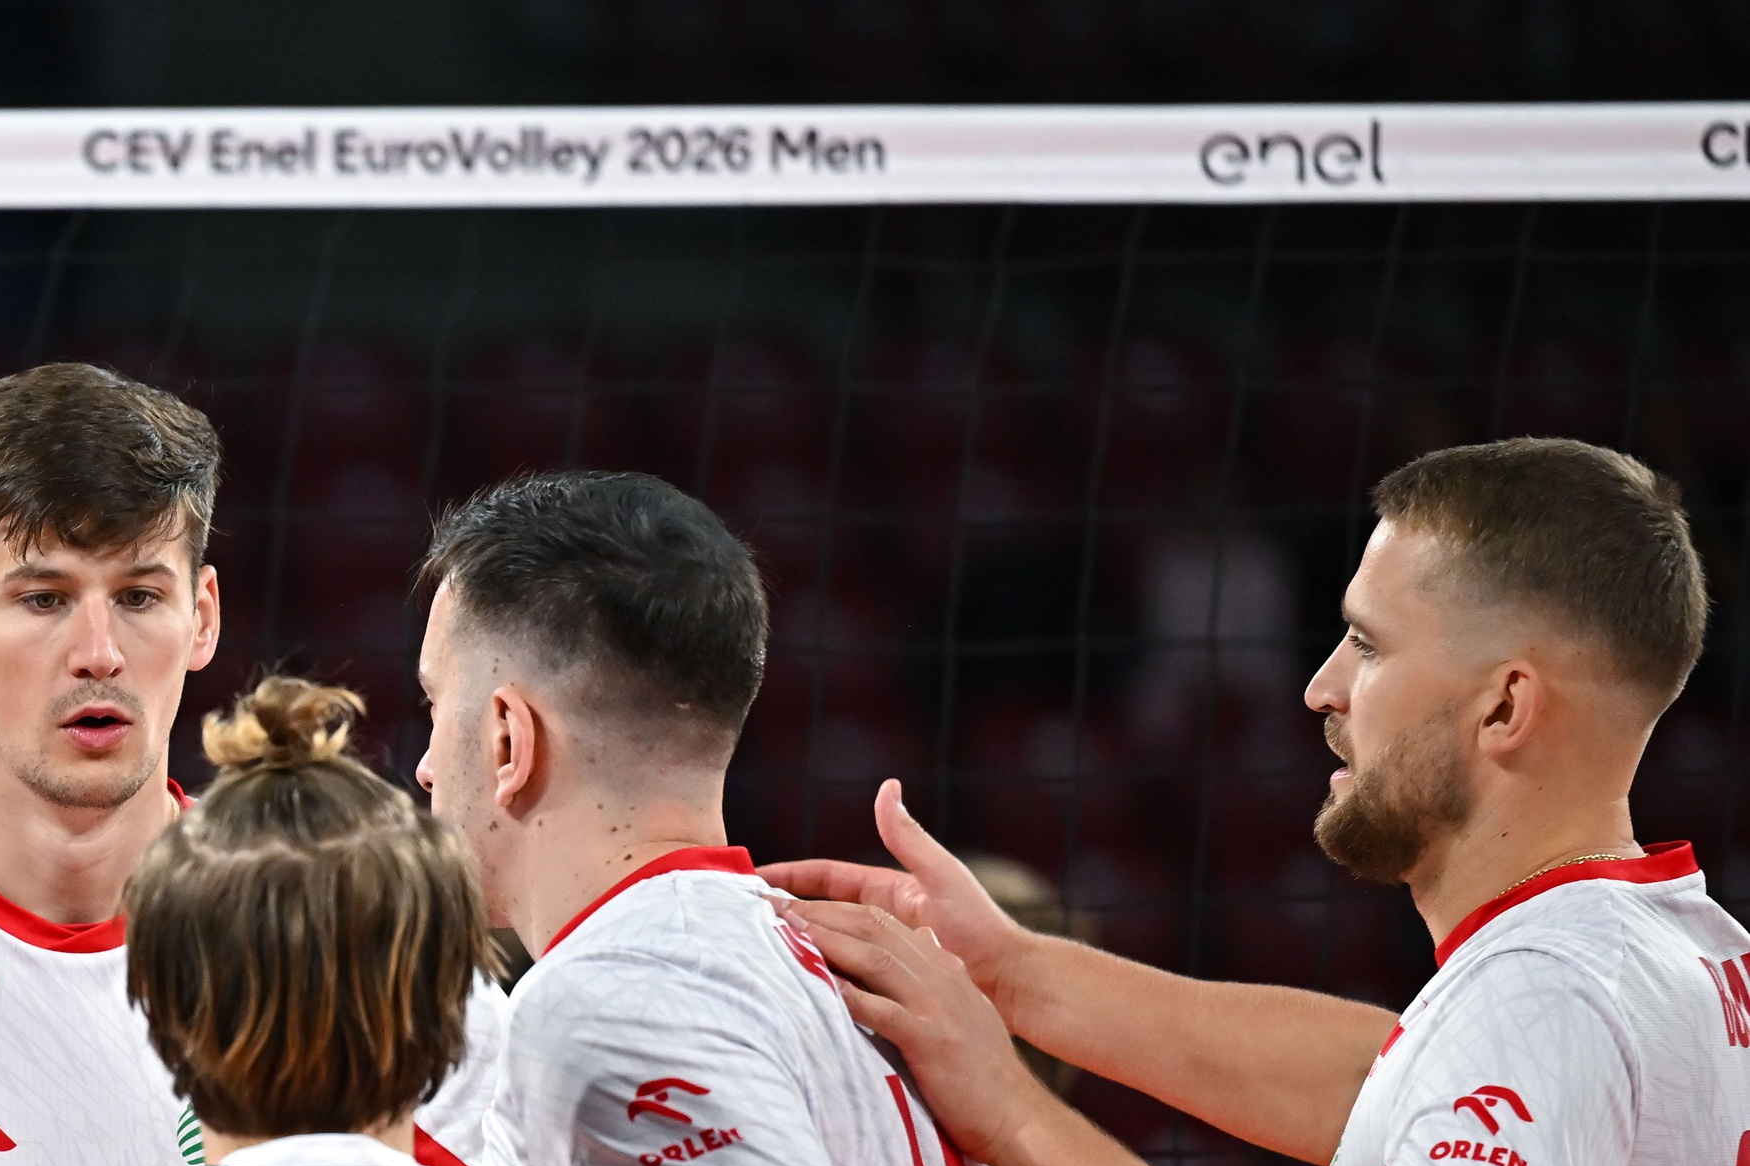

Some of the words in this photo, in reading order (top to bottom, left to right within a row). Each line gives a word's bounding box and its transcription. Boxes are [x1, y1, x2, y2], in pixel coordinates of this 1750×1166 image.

[83, 127, 194, 175] CEV
[209, 126, 317, 174] Enel
[334, 125, 611, 184] EuroVolley
[624, 126, 751, 174] 2026
[770, 125, 888, 174] Men
[1199, 118, 1384, 186] enel
[1700, 121, 1750, 168] C
